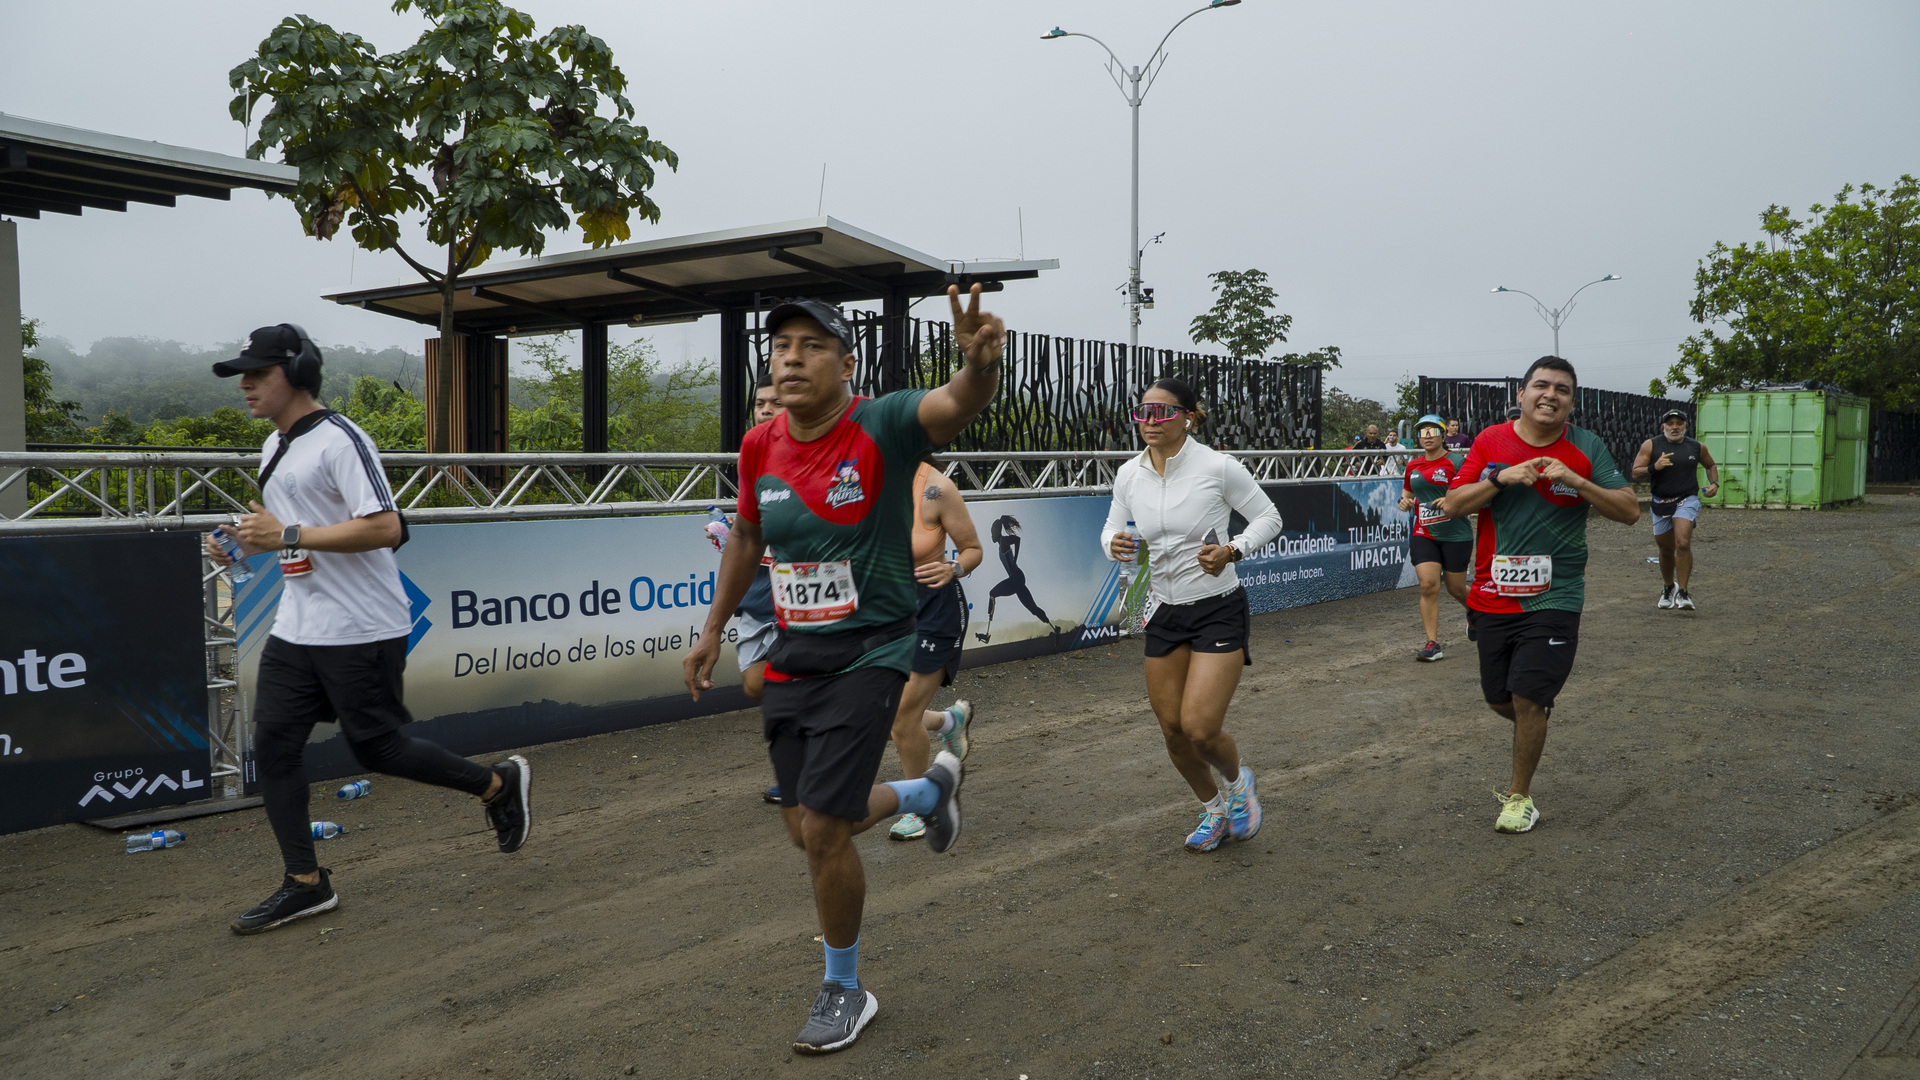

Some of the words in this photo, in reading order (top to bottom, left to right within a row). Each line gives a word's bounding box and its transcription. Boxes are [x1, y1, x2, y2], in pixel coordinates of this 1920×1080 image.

[1278, 534, 1335, 557] Occidente
[1348, 527, 1363, 546] TU
[1366, 523, 1405, 544] HACER,
[1350, 545, 1405, 571] IMPACTA.
[1256, 571, 1267, 585] de
[1268, 569, 1281, 583] los
[1282, 570, 1297, 585] que
[1299, 566, 1324, 581] hacen.
[1500, 568, 1539, 583] 2221
[451, 590, 571, 629] Banco
[579, 580, 621, 617] de
[629, 571, 715, 612] Occid
[785, 581, 840, 605] 1874
[1081, 625, 1117, 641] AVAL
[455, 648, 497, 678] Del
[506, 643, 562, 671] lado
[568, 638, 597, 664] de
[605, 634, 636, 658] los
[643, 633, 683, 658] que
[0, 648, 87, 695] nte
[93, 767, 144, 782] Grupo
[78, 769, 204, 808] AVAL
